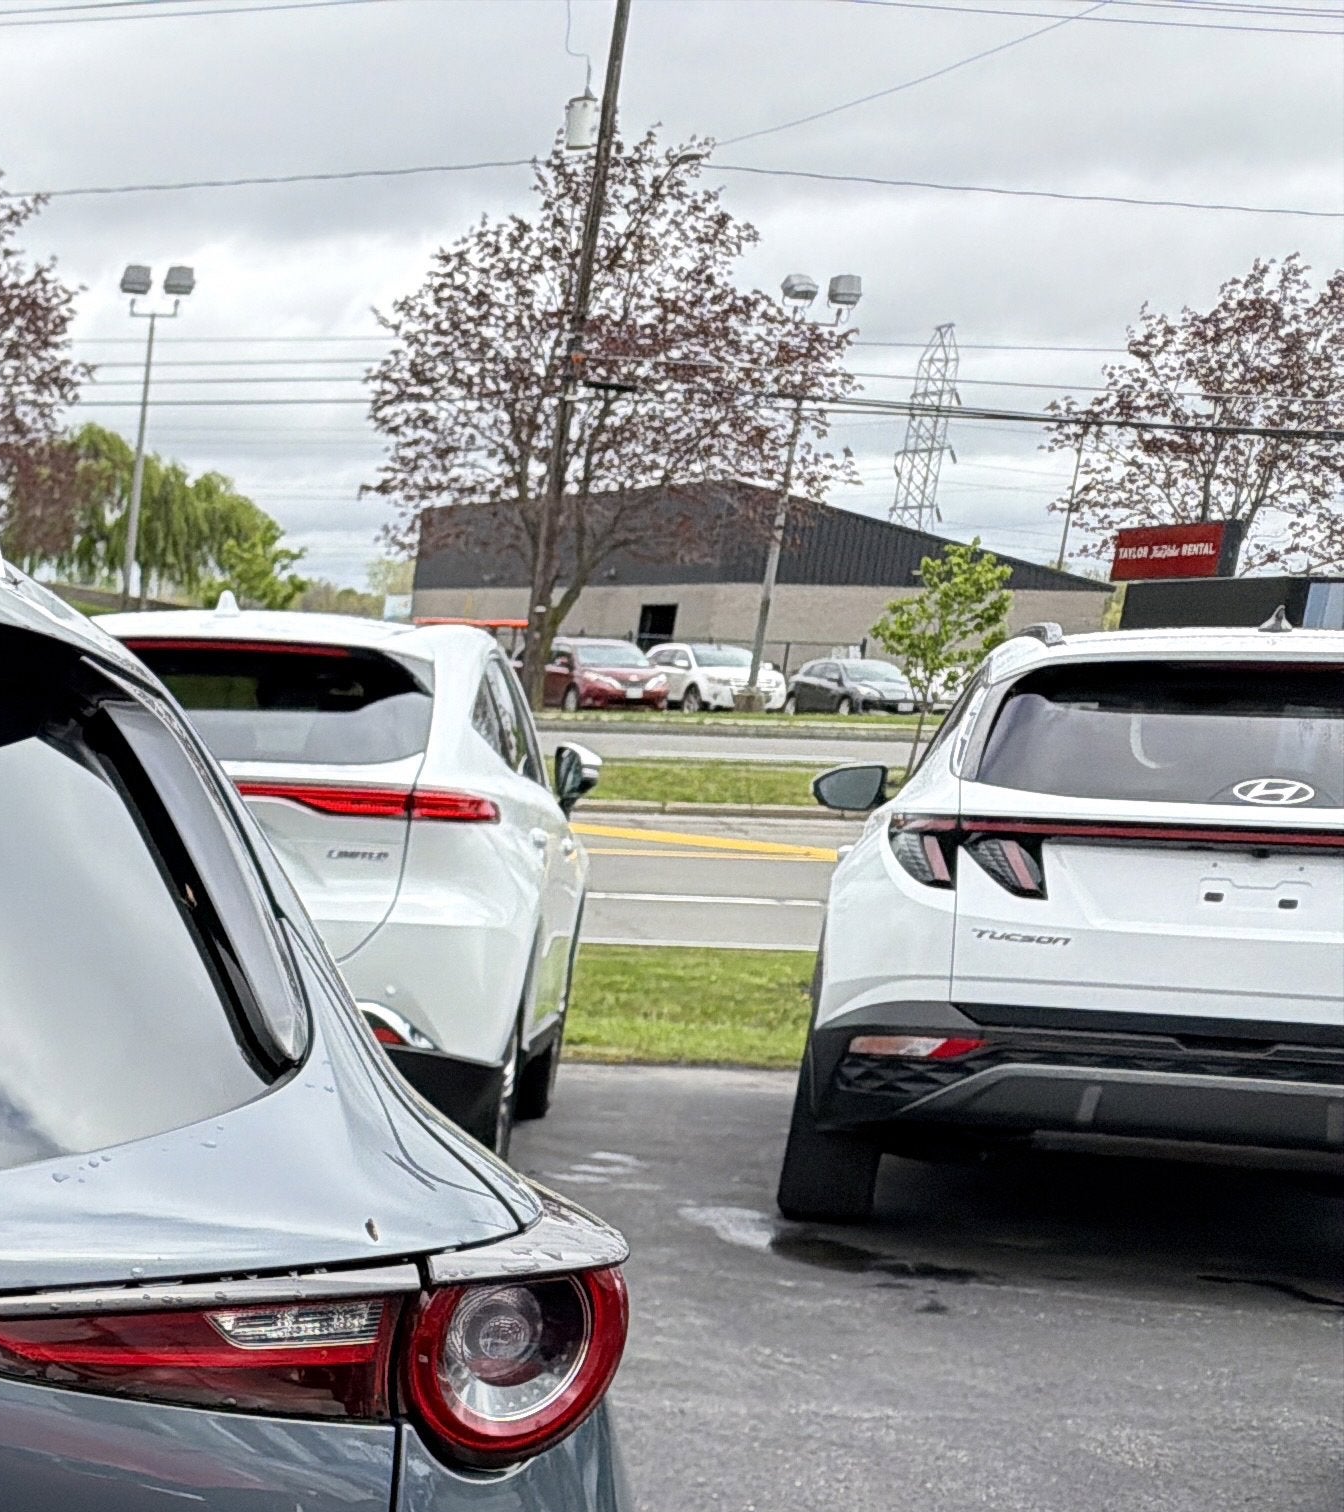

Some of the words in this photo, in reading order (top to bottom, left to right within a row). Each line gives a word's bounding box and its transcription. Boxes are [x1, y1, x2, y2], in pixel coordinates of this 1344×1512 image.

[1118, 545, 1148, 560] TAYLOR
[1181, 542, 1217, 557] RENTAL
[971, 927, 1072, 947] TUCSON
